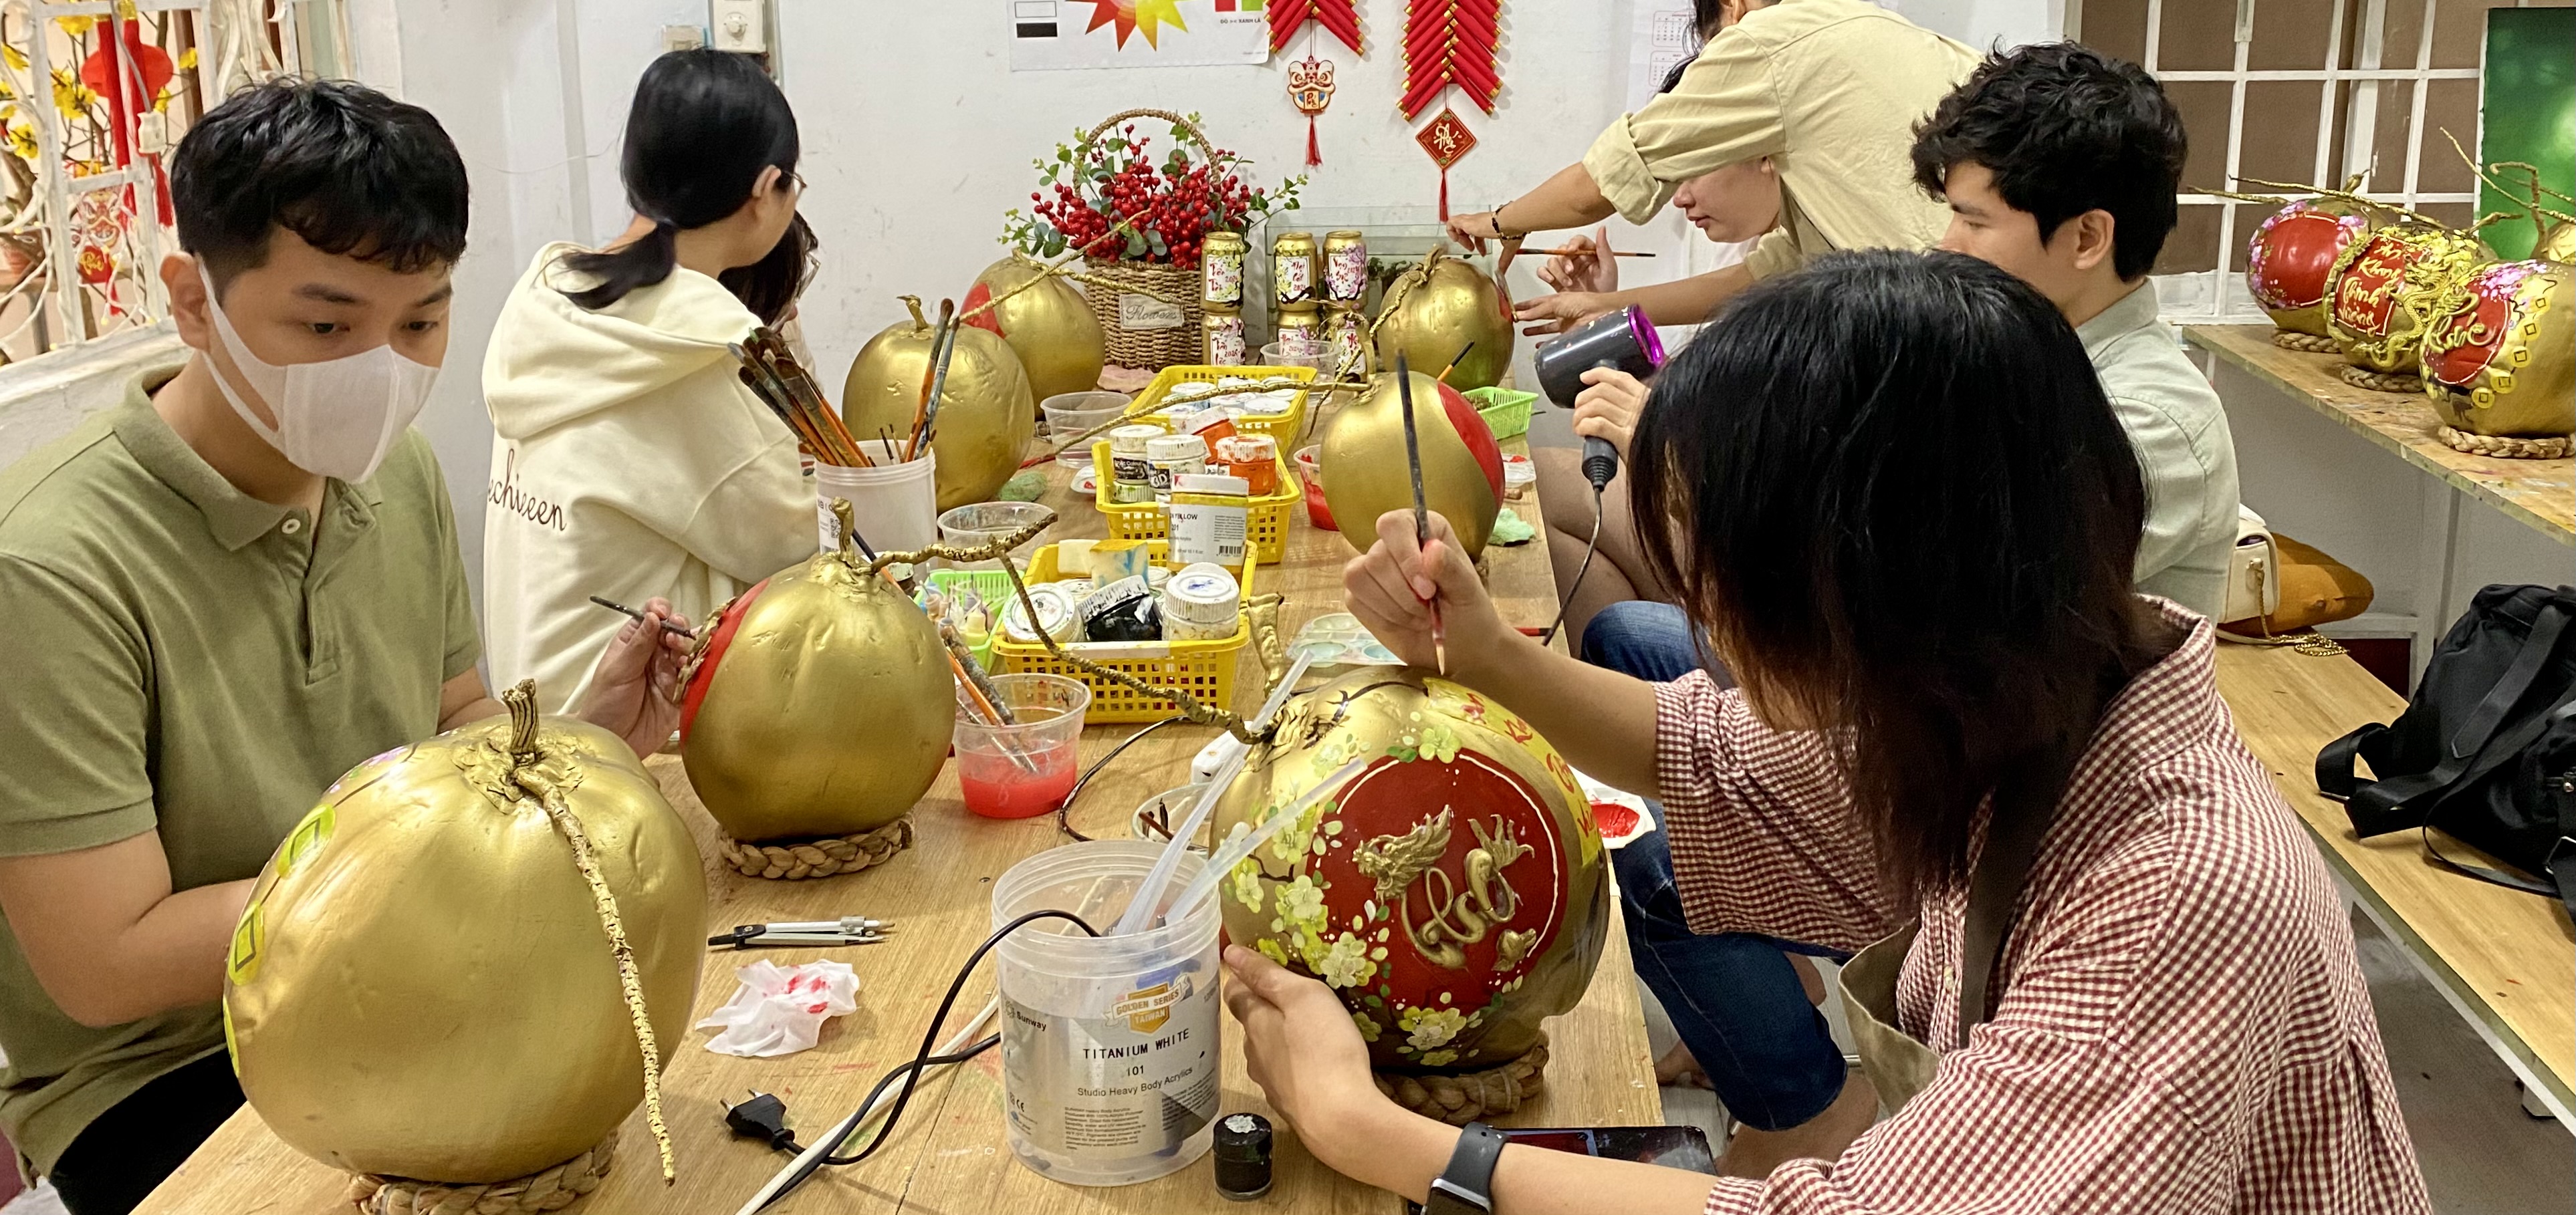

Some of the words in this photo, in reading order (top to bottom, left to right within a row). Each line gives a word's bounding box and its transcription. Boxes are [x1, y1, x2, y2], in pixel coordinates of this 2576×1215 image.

[1126, 304, 1177, 321] Flowers
[1116, 1000, 1149, 1016] GOLDEN
[1153, 988, 1179, 1006] SERIES
[1016, 1010, 1046, 1031] Sunway
[1135, 1009, 1165, 1024] TAIWAN
[1083, 1043, 1148, 1059] TITANIUM
[1155, 1028, 1189, 1051] WHITE
[1127, 1065, 1144, 1077] 101
[1078, 1087, 1106, 1097] Studio
[1109, 1087, 1138, 1096] Heavy
[1141, 1079, 1163, 1092] Body
[1164, 1067, 1193, 1085] Acrylics
